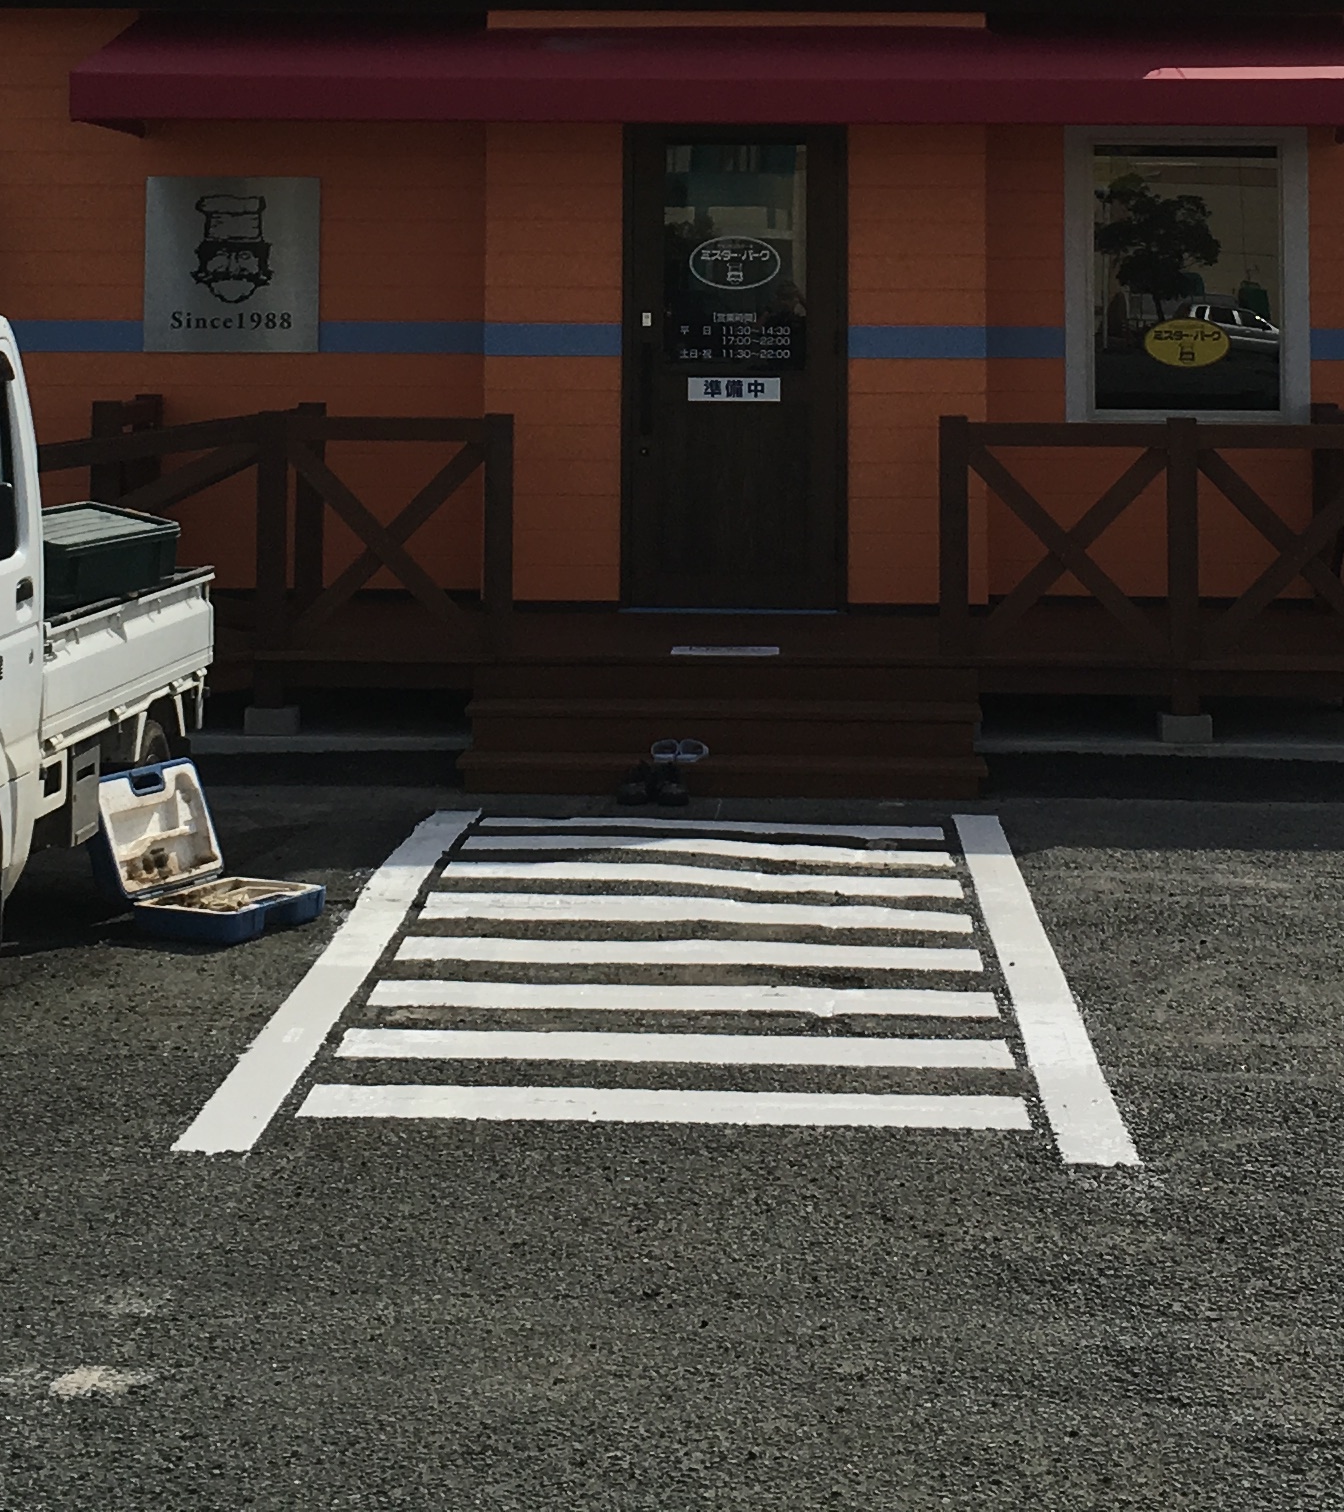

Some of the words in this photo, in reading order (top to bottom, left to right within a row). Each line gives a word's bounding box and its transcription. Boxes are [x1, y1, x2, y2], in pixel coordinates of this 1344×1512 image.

[170, 310, 292, 330] Since1988
[703, 379, 765, 398] 準備中
